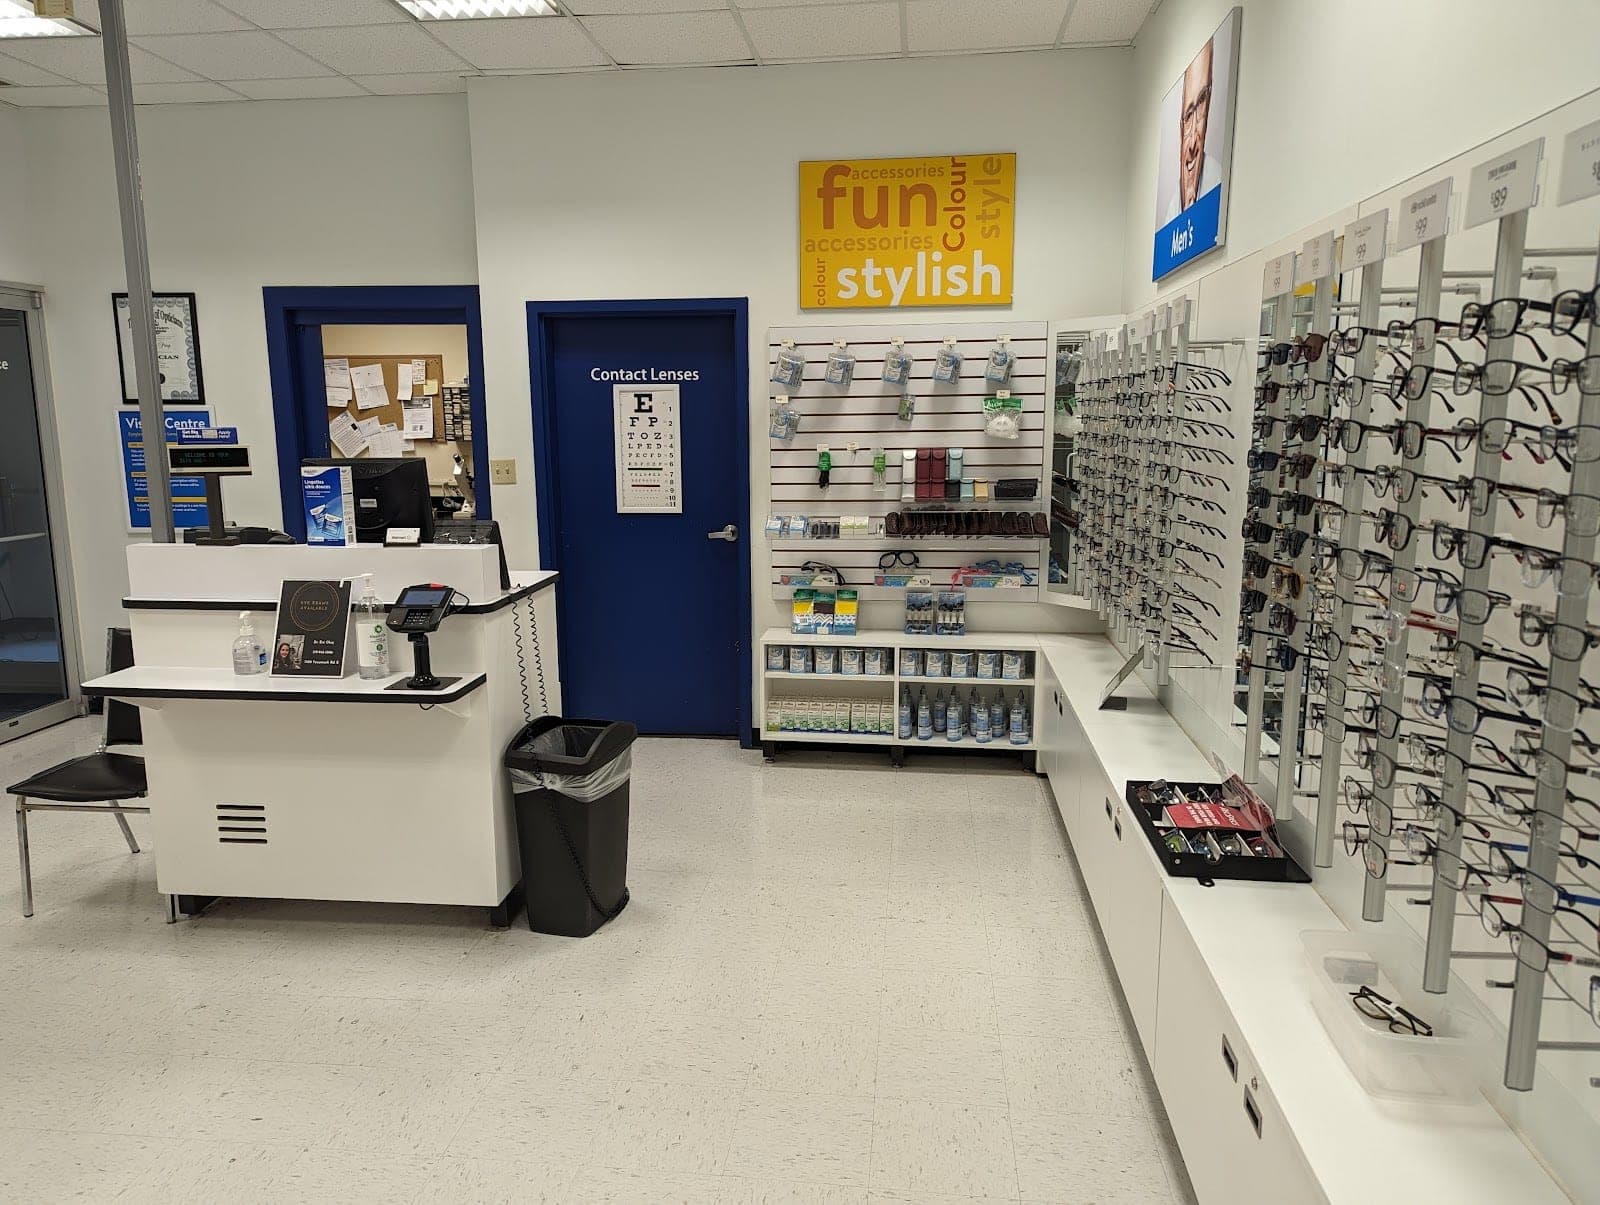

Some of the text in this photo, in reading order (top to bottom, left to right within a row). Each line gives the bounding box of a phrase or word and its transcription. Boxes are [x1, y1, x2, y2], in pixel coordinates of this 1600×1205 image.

[852, 163, 945, 180] accessories
[817, 164, 938, 229] fun
[942, 156, 967, 252] Colour
[973, 156, 1010, 239] style
[804, 230, 934, 253] accessories
[1170, 218, 1194, 258] Men's
[812, 257, 826, 306] colour
[837, 249, 1001, 306] stylish
[590, 367, 700, 381] Contact Lenses
[633, 393, 653, 413] E
[164, 417, 206, 429] Centre
[629, 416, 640, 427] F
[648, 416, 658, 427] P
[627, 432, 635, 440] T
[640, 432, 649, 440] O
[654, 432, 662, 440] Z
